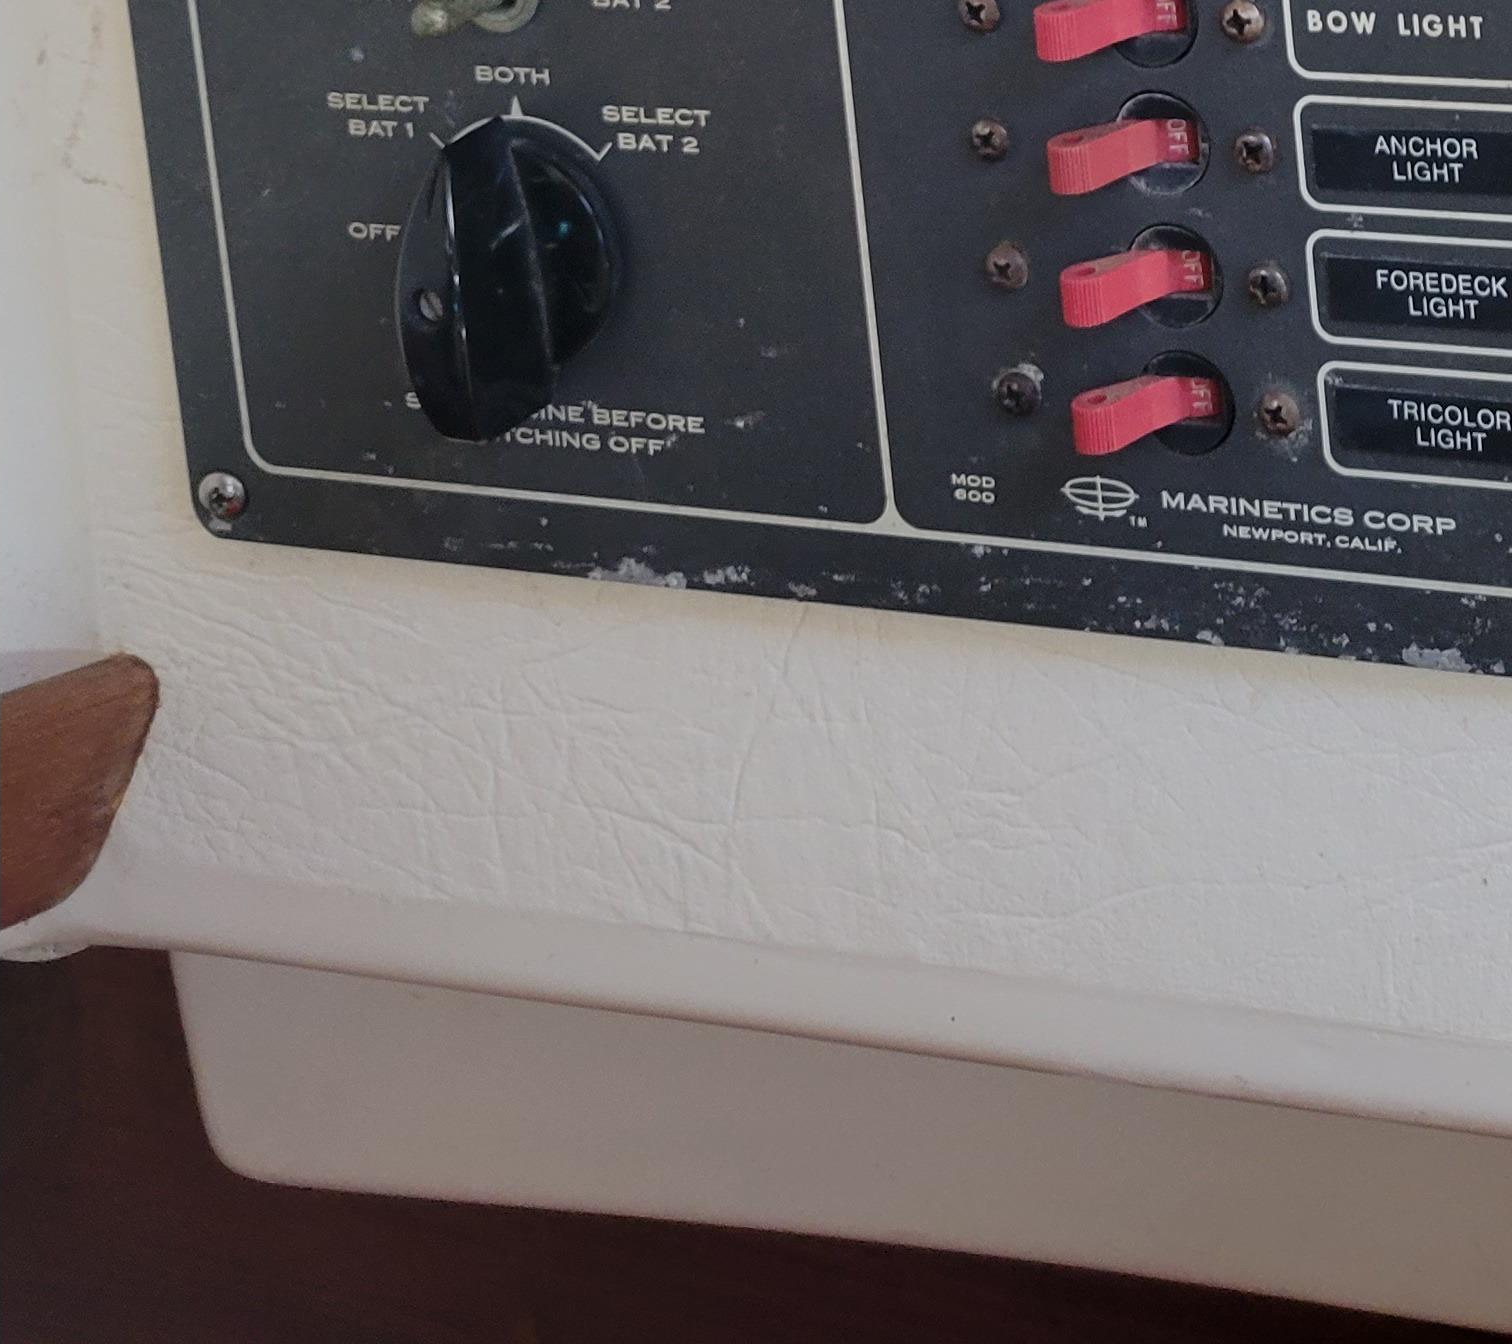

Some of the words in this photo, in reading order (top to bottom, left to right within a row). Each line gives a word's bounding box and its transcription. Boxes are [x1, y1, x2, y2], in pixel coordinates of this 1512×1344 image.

[1306, 9, 1377, 35] BOW
[1397, 13, 1484, 39] LIGHT
[474, 65, 551, 86] BOTH
[327, 92, 430, 114] SELECT
[348, 119, 396, 139] BAT
[404, 121, 414, 139] 1
[601, 104, 711, 129] SELECT
[618, 132, 673, 153] BAT
[682, 136, 700, 154] 2
[1167, 118, 1189, 156] OFF
[1374, 134, 1478, 160] ANCHOR
[1392, 160, 1464, 184] LIGHT
[348, 222, 402, 242] OFF
[1181, 249, 1204, 289] OFF
[1376, 268, 1508, 299] FOREDECK
[1408, 295, 1480, 320] LIGHT
[592, 407, 706, 435] BEFORE
[1388, 398, 1512, 432] TRICOLOR
[1416, 426, 1487, 452] LIGHT
[951, 472, 996, 489] MOD
[953, 488, 996, 505] 600
[1160, 489, 1355, 527] MARINETICS
[1363, 510, 1458, 536] CORP
